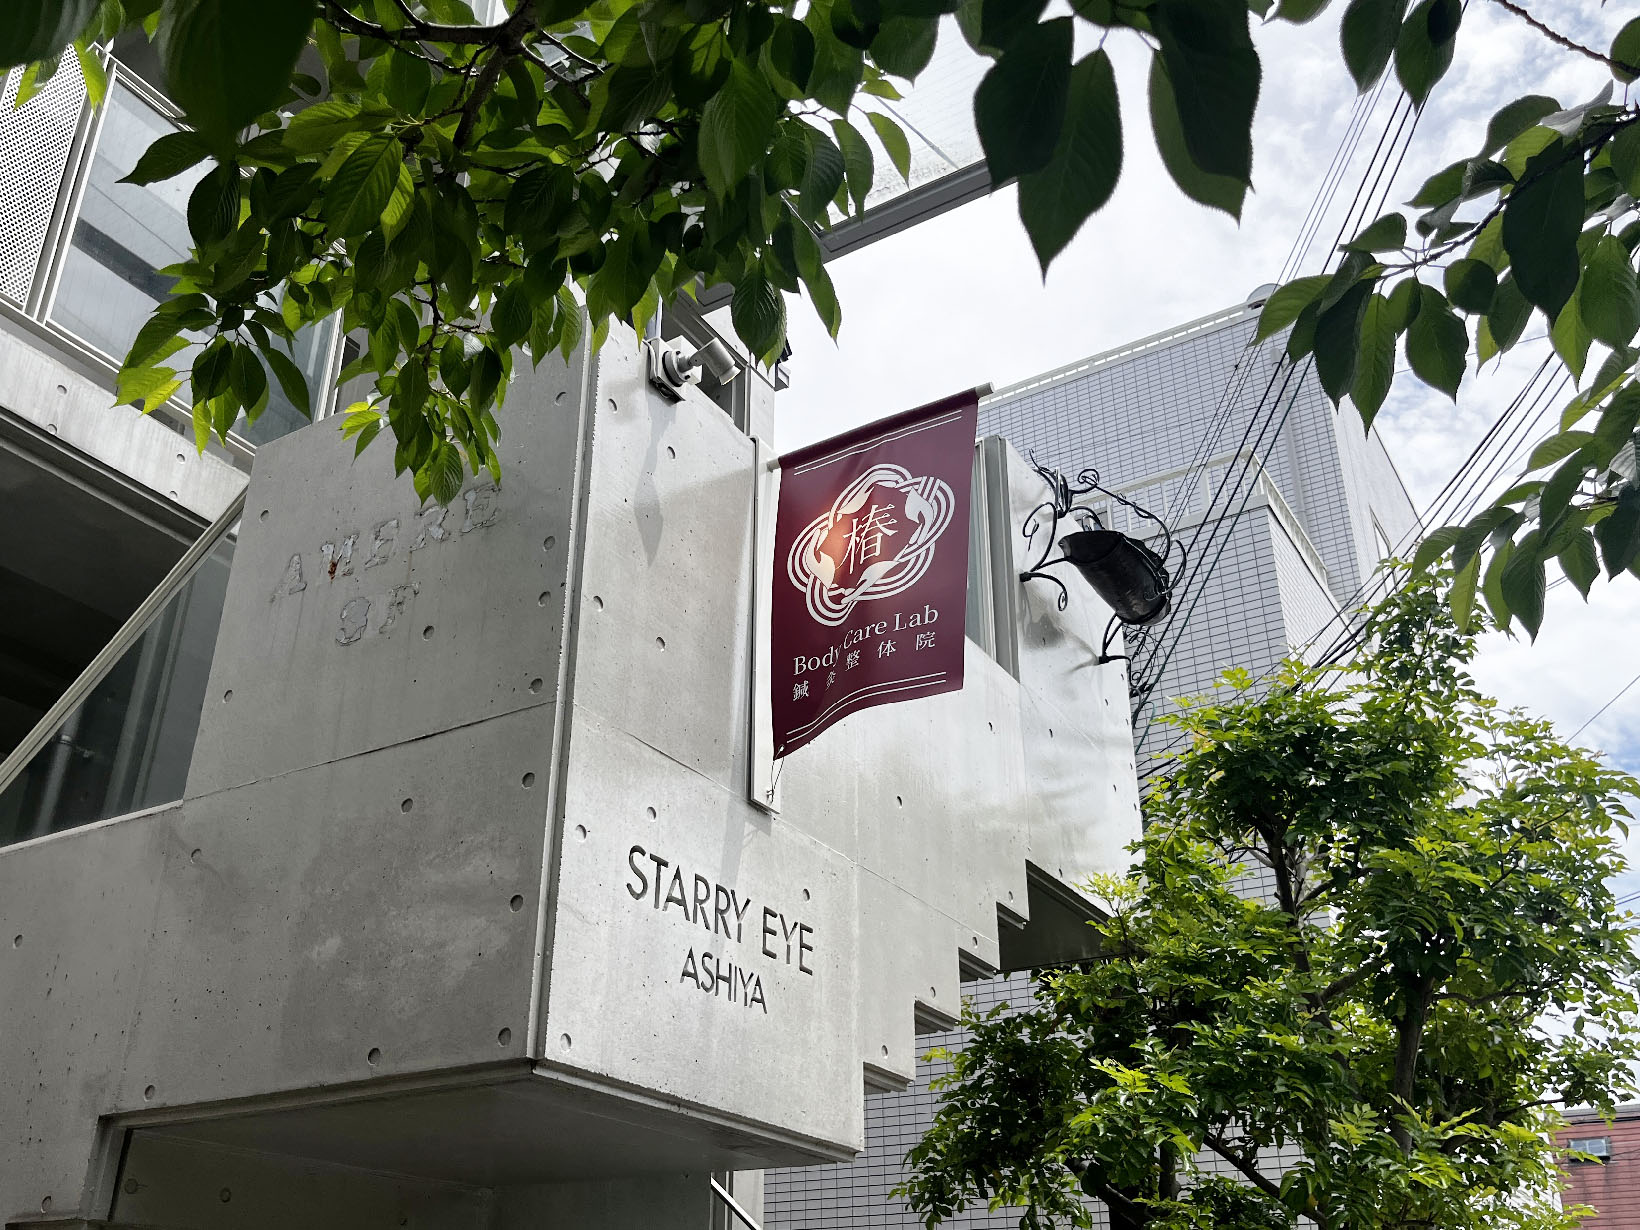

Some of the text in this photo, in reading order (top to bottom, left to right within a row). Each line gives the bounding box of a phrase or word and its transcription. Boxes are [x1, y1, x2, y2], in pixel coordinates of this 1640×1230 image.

[835, 503, 898, 575] 椿
[793, 604, 939, 676] Body Care Lab
[626, 844, 814, 976] STARRY EYE
[679, 946, 768, 1015] ASHIYA
